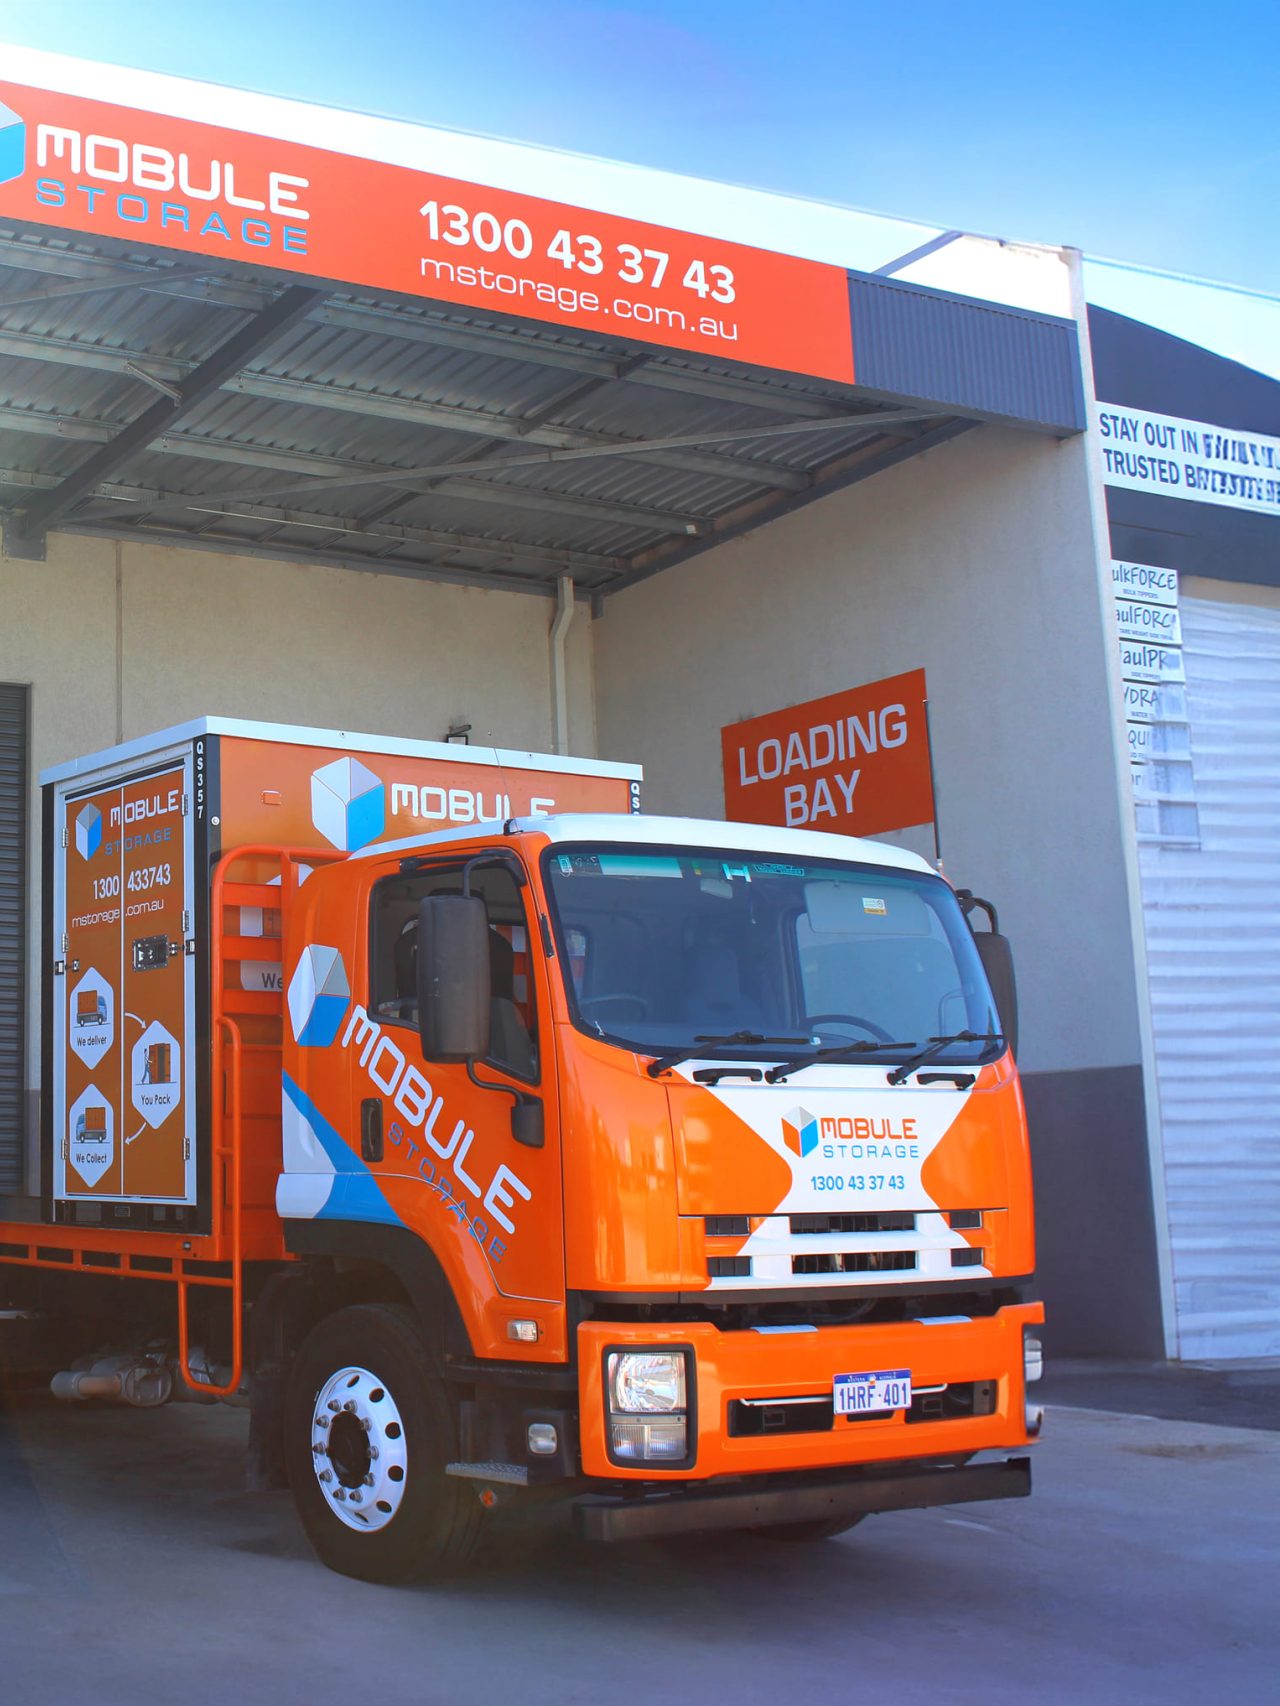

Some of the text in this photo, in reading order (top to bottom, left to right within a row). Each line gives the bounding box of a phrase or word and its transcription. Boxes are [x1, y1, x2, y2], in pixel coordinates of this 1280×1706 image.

[36, 123, 311, 220] MOBULE
[35, 178, 308, 255] STORAGE
[419, 200, 736, 303] 1300 43 37 43
[421, 257, 738, 341] mstorage.com.au
[1099, 412, 1139, 443] STAY
[1144, 422, 1176, 450] OUT
[1180, 429, 1198, 455] IN
[1102, 448, 1180, 485] TRUSTED
[1116, 605, 1175, 629] aulFORC
[738, 703, 908, 786] LOADING
[110, 789, 179, 828] MOBULE
[630, 782, 641, 816] QS
[784, 769, 861, 827] BAY
[104, 827, 172, 856] STORAGE
[93, 863, 171, 900] 1300 433743
[77, 1036, 107, 1047] We deliver
[141, 1094, 171, 1106] You Pack
[342, 1004, 532, 1234] MOBULE
[820, 1117, 918, 1140] MOBULE
[76, 1153, 107, 1164] We Collect
[823, 1145, 919, 1158] STORAGE
[387, 1121, 508, 1263] STORAGE
[811, 1175, 905, 1190] 1300 43 37 43
